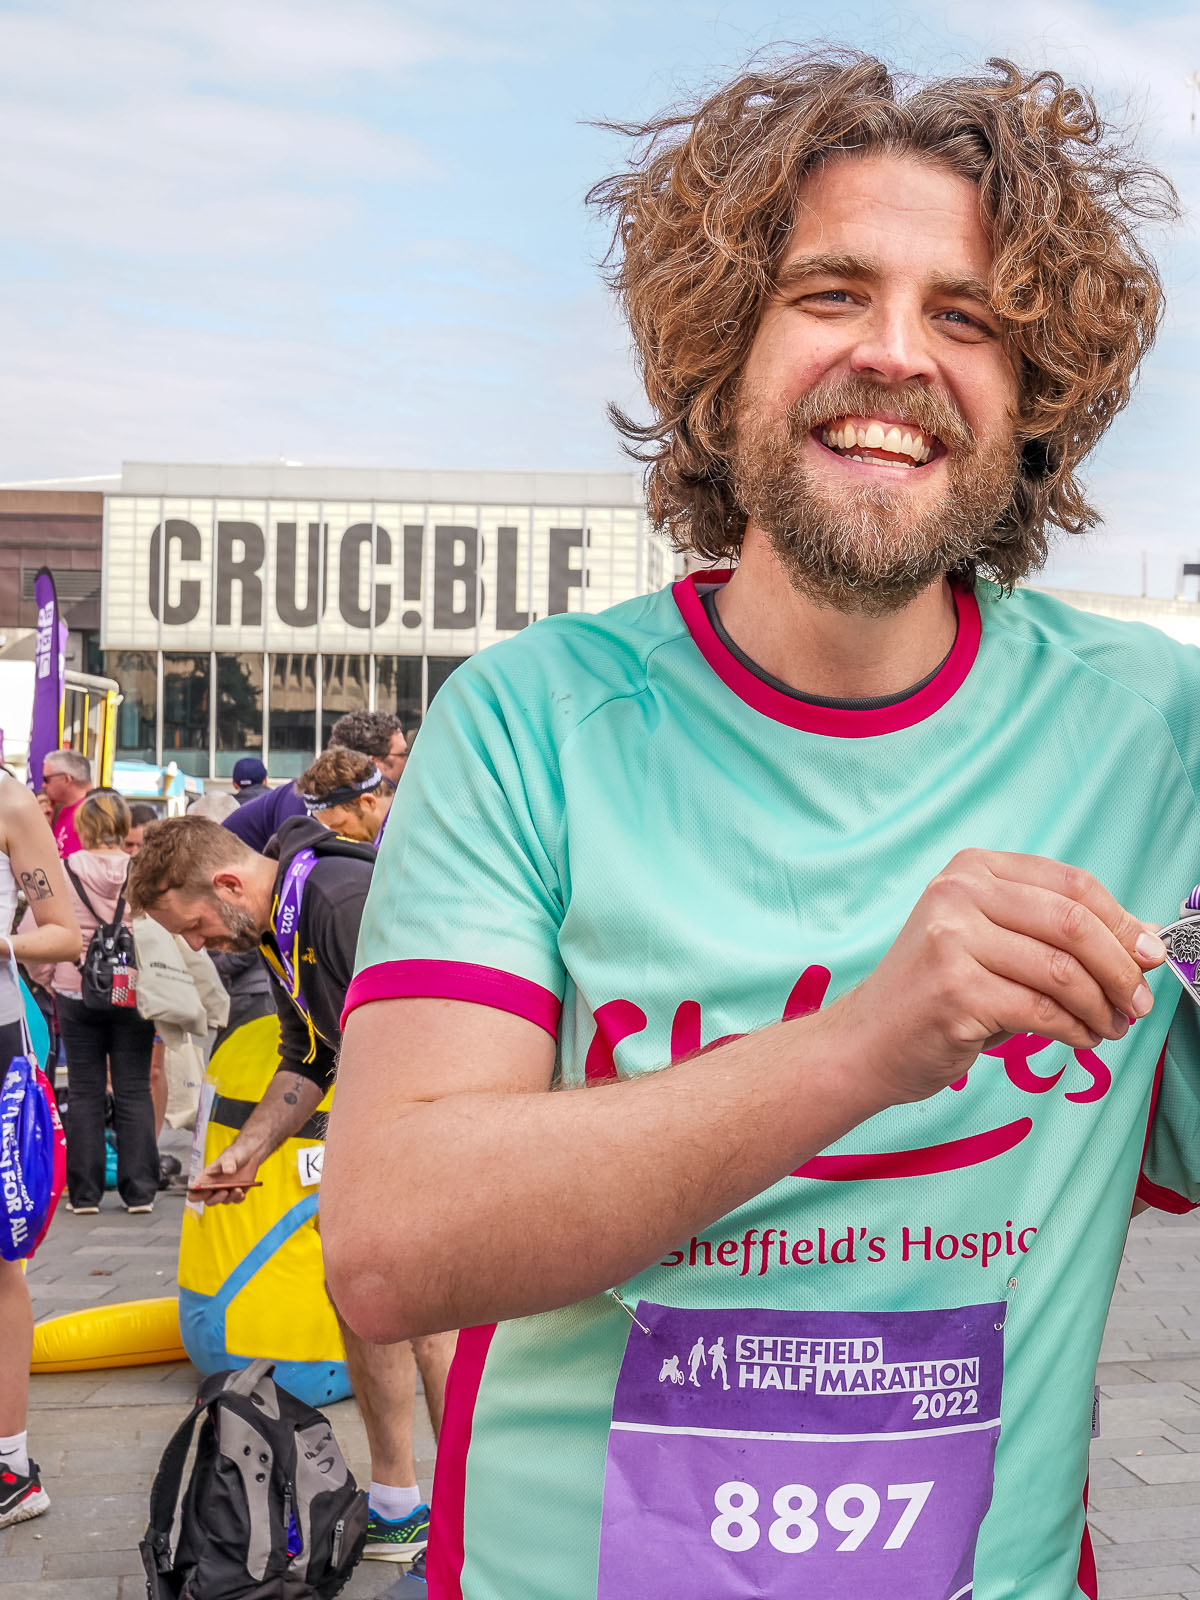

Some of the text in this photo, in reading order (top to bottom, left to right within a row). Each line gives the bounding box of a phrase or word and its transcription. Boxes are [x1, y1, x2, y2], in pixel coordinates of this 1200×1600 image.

[281, 905, 295, 934] 2022
[1, 1169, 23, 1214] FOR
[9, 1217, 29, 1248] ALL
[902, 1220, 1038, 1268] Hospic
[740, 1337, 879, 1365] SHEFFIELD
[739, 1360, 977, 1393] HALF MARATHON
[912, 1389, 978, 1421] 2022
[710, 1481, 935, 1554] 8897
